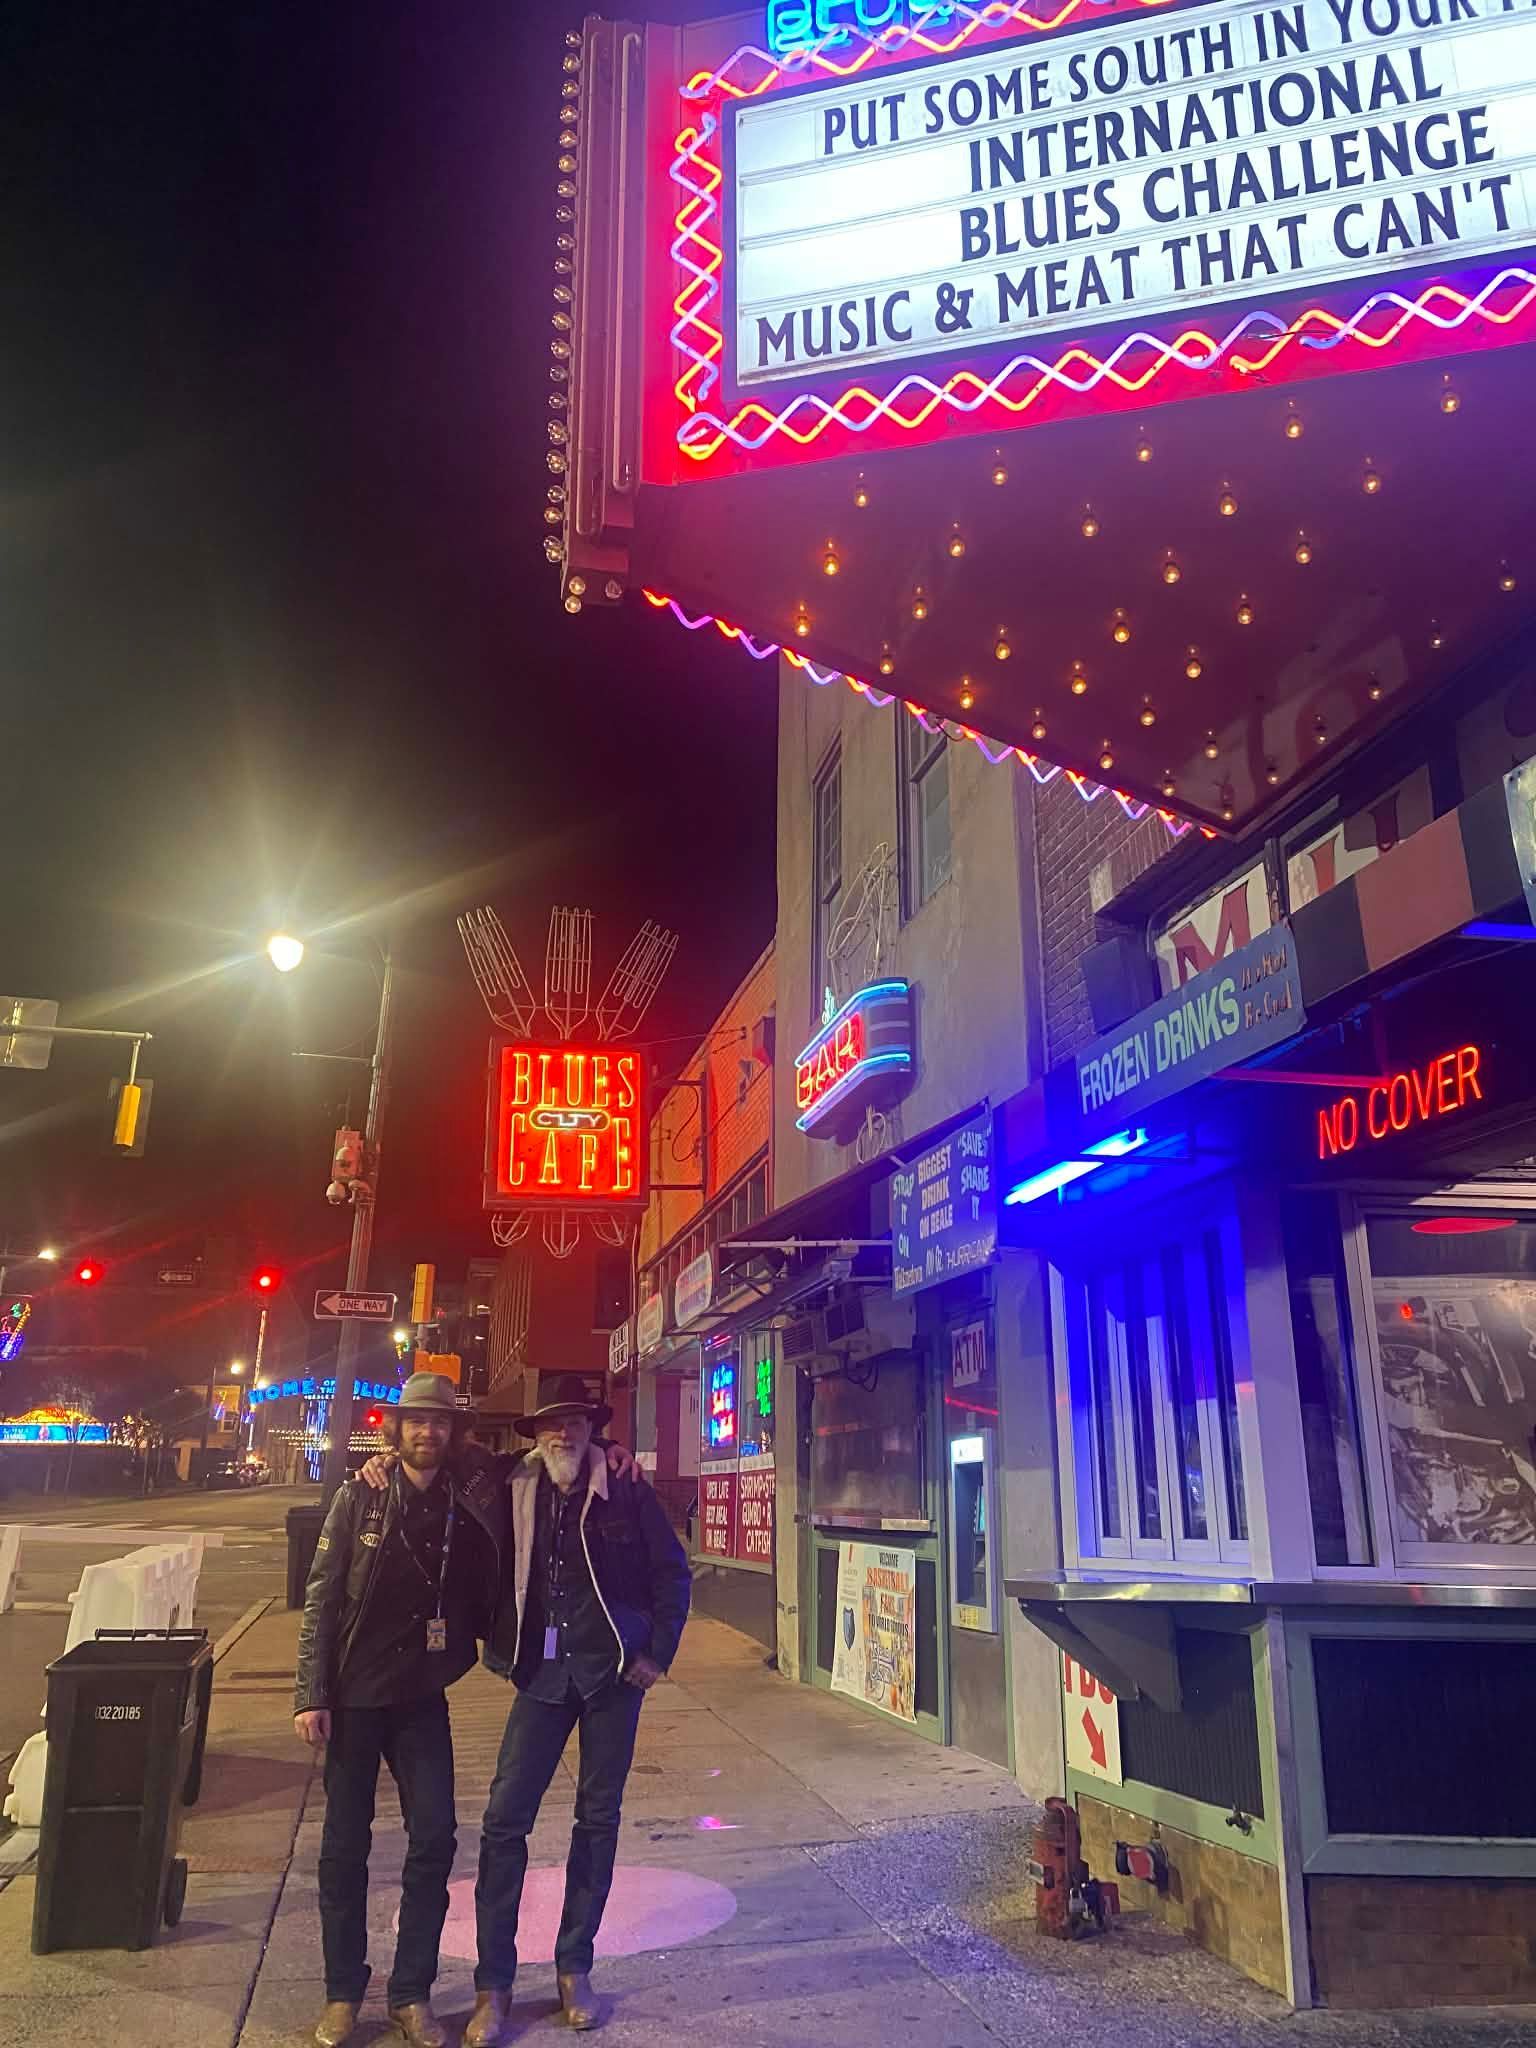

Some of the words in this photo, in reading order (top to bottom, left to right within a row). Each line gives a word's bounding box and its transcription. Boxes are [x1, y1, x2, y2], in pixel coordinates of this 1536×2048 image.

[823, 93, 906, 155] PUT
[924, 61, 1052, 134] SOME
[1068, 22, 1233, 102] SOUTH
[1253, 5, 1310, 61] IN
[969, 46, 1443, 192] INTERNATIONAL
[960, 176, 1120, 261] BLUES
[1143, 105, 1494, 223] CHALLENGE
[756, 290, 912, 366] MUSIC
[935, 282, 974, 333] &
[995, 246, 1143, 324] MEAT
[1162, 214, 1307, 291] THAT
[1333, 174, 1512, 258] CAN'T
[797, 1018, 857, 1108] BAR
[1079, 1030, 1151, 1116] FROZEN
[1153, 977, 1240, 1074] DRINKS
[511, 1053, 635, 1108] BLUES
[1319, 1096, 1359, 1160] NO
[1368, 1044, 1484, 1139] COVER
[537, 1112, 602, 1128] CITY
[509, 1113, 631, 1190] CAFE
[917, 1143, 952, 1184] BIGGEST
[921, 1176, 950, 1211] DRINK
[961, 1166, 989, 1194] SHARE
[900, 1202, 908, 1226] IT
[919, 1216, 930, 1240] ON
[931, 1204, 953, 1236] BEALE
[971, 1195, 980, 1221] IT
[898, 1233, 910, 1258] ON
[338, 1298, 360, 1310] ONE
[363, 1299, 385, 1312] WAY
[953, 1330, 986, 1377] ATM
[248, 1379, 314, 1404] HOME
[718, 1480, 729, 1500] LATE
[740, 1475, 763, 1500] SHRIMP
[742, 1501, 761, 1528] GUMBO
[746, 1529, 772, 1555] CATFISH
[866, 1567, 910, 1594] BASKETBALL
